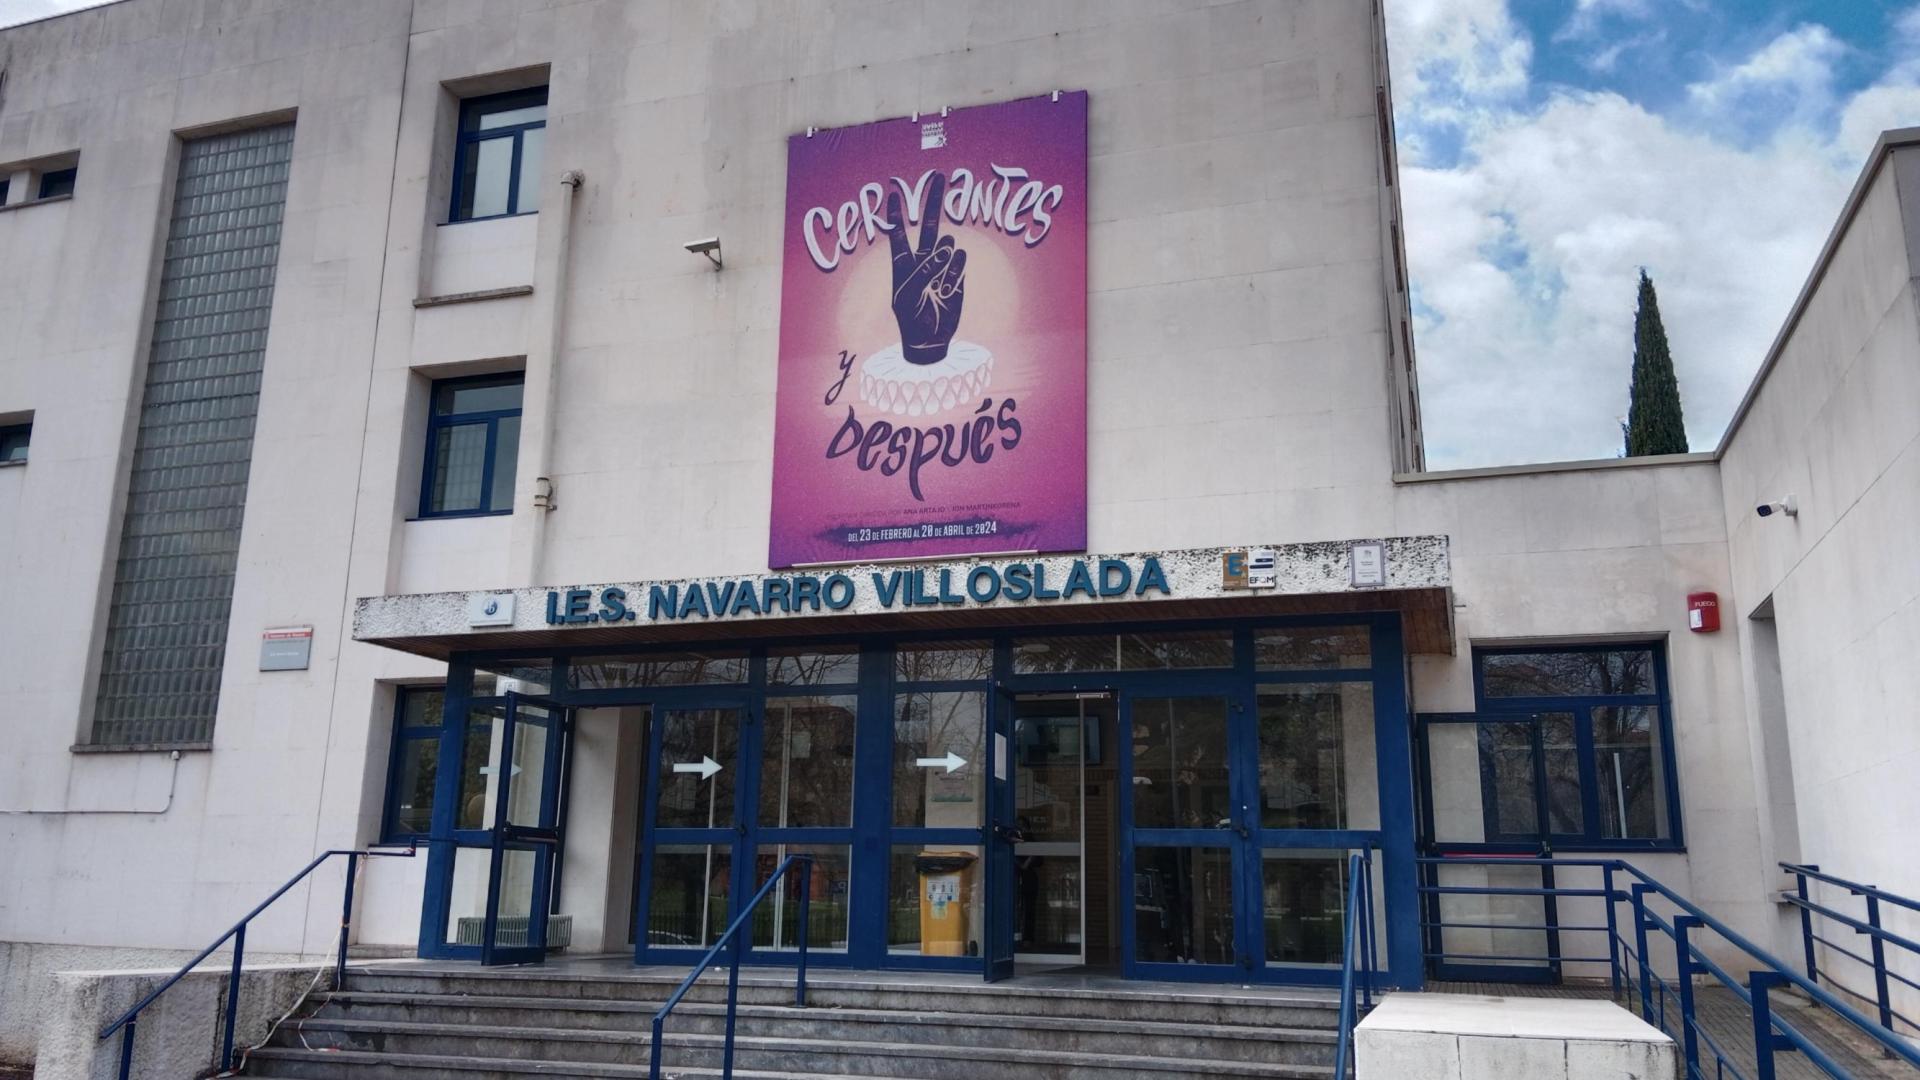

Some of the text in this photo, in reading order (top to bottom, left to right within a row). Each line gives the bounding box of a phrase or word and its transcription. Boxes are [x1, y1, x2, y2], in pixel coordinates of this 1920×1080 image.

[825, 349, 857, 405] y
[848, 533, 858, 542] DEL
[860, 529, 871, 541] 23
[872, 532, 880, 541] DE
[880, 528, 912, 540] FEBRERO
[922, 525, 933, 537] 20
[935, 529, 942, 537] DE
[943, 523, 965, 536] ABRIL
[966, 527, 973, 535] DE
[975, 521, 997, 534] 2024
[546, 557, 1170, 624] I.E.S. NAVARRO VILLOSLADA
